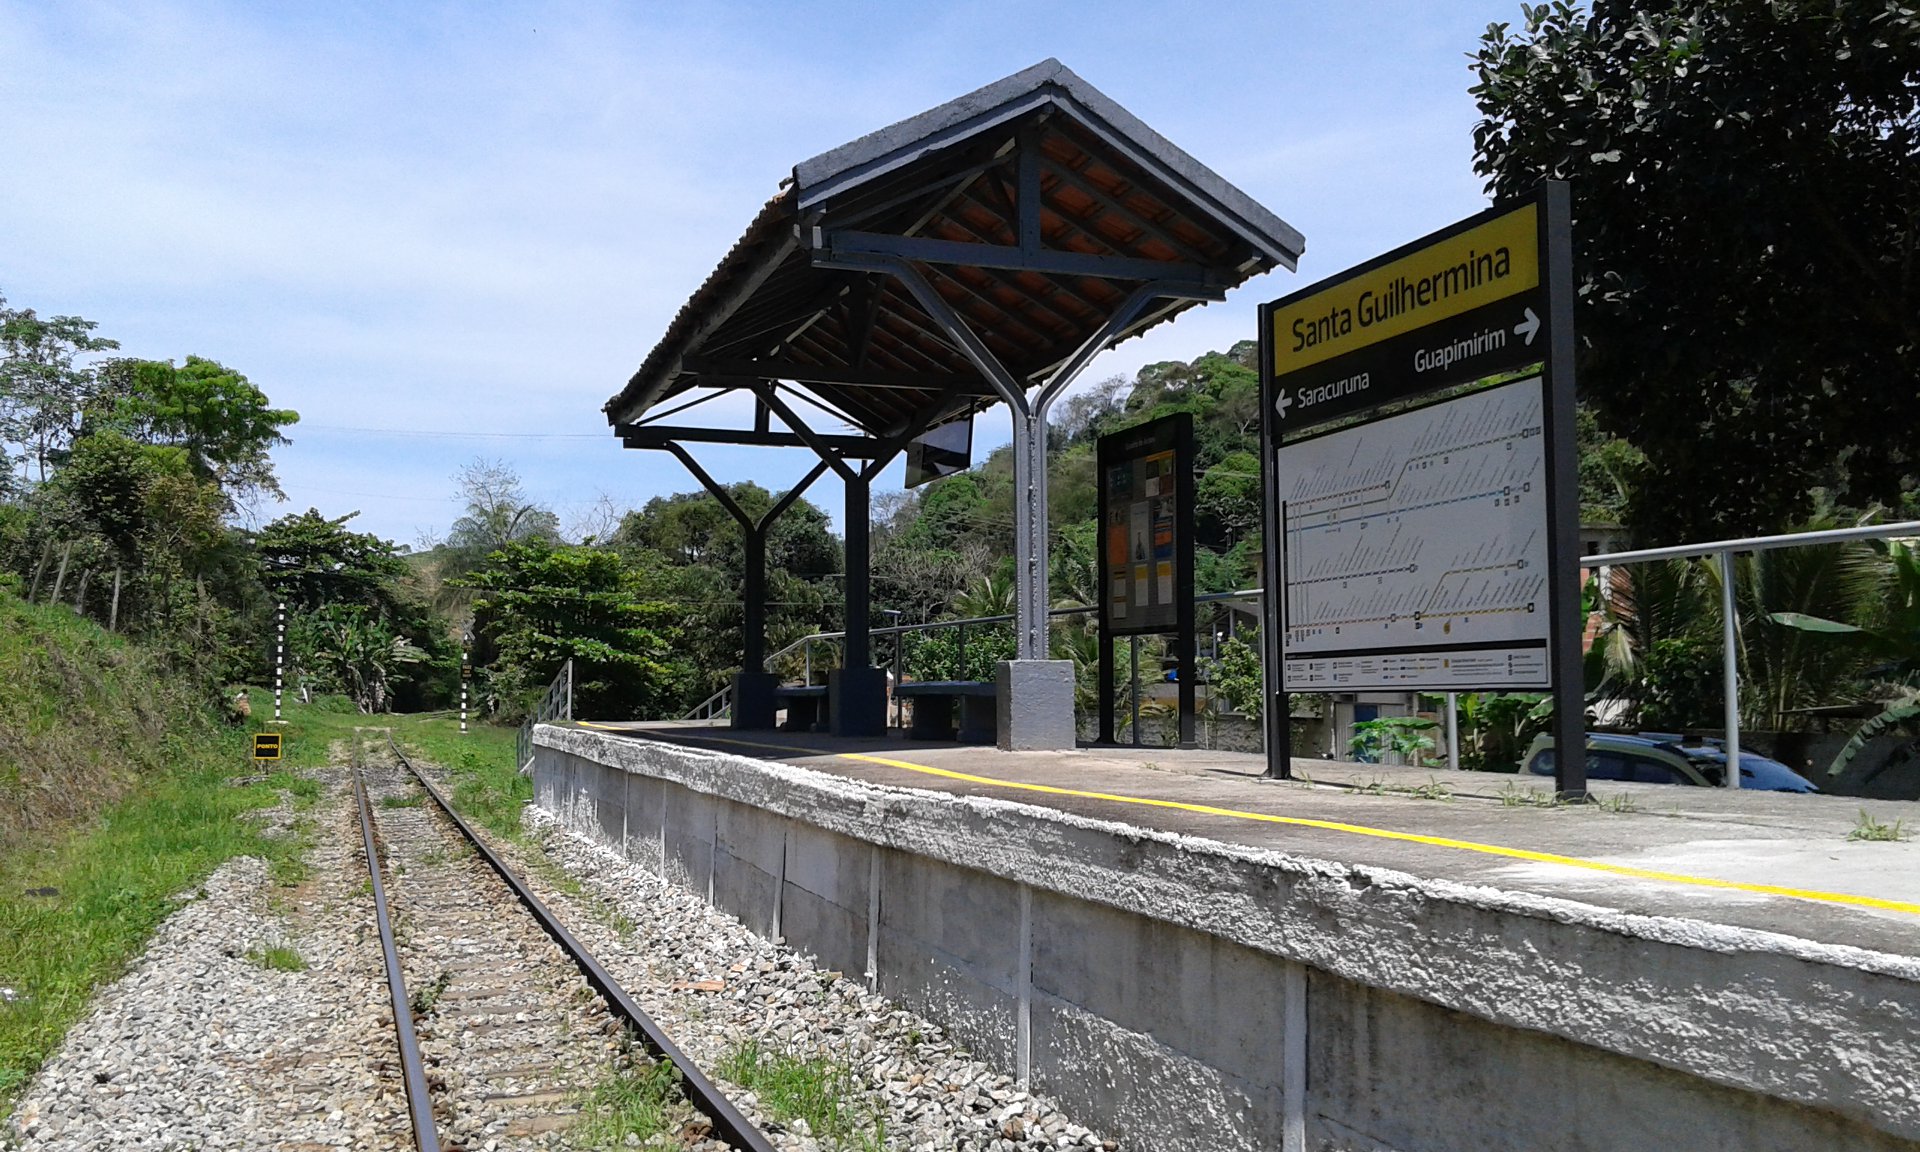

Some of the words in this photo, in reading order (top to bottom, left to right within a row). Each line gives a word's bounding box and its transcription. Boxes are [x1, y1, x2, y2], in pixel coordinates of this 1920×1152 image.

[1292, 306, 1352, 353] Santa
[1357, 246, 1511, 329] Guilhermina
[1414, 328, 1506, 373] Guapimirim
[1297, 372, 1370, 409] Saracuruna
